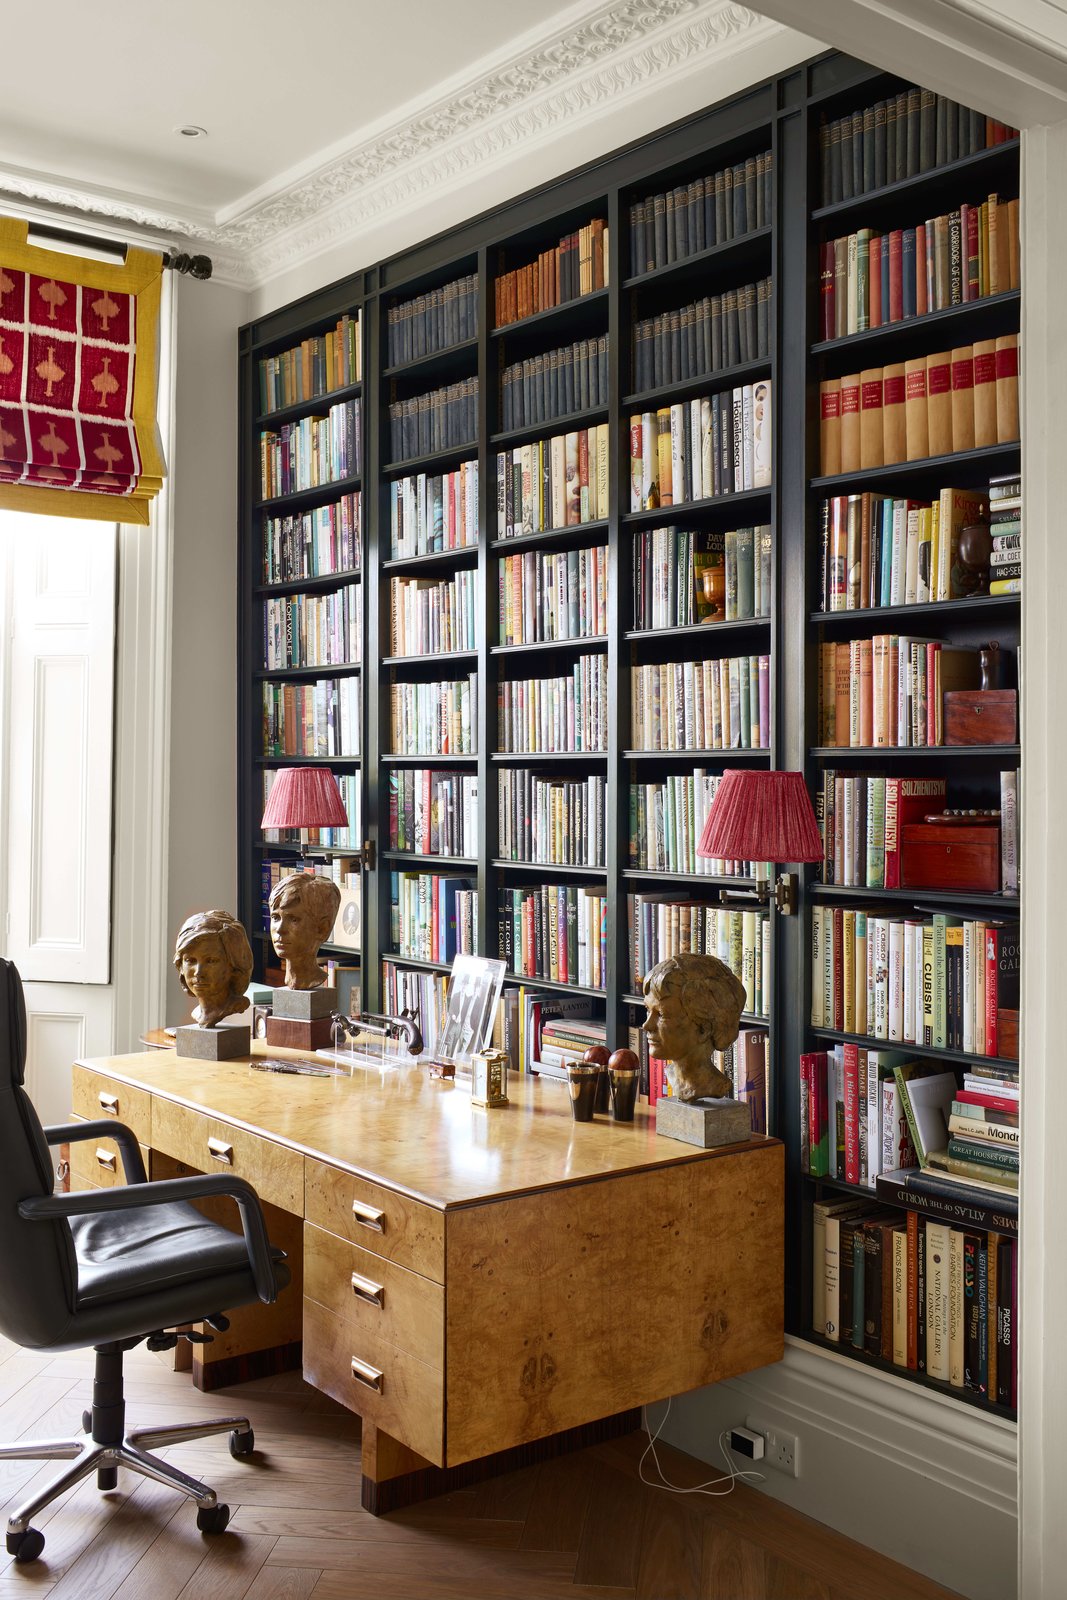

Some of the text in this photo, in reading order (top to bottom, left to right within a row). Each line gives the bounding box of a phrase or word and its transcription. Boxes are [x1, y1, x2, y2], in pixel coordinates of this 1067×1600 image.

[951, 226, 960, 304] CORRIDORS OF POWER
[885, 786, 897, 852] SOLZHENITSYN
[880, 953, 885, 962] OF
[542, 1001, 590, 1014] PETER LANYON
[896, 1074, 914, 1126] VIRGINIA WOOLF
[953, 1146, 972, 1154] GREAT
[973, 1148, 997, 1160] HOUSES
[897, 1191, 928, 1207] WORLD
[954, 1206, 986, 1221] ATLAS
[909, 1272, 914, 1283] OF
